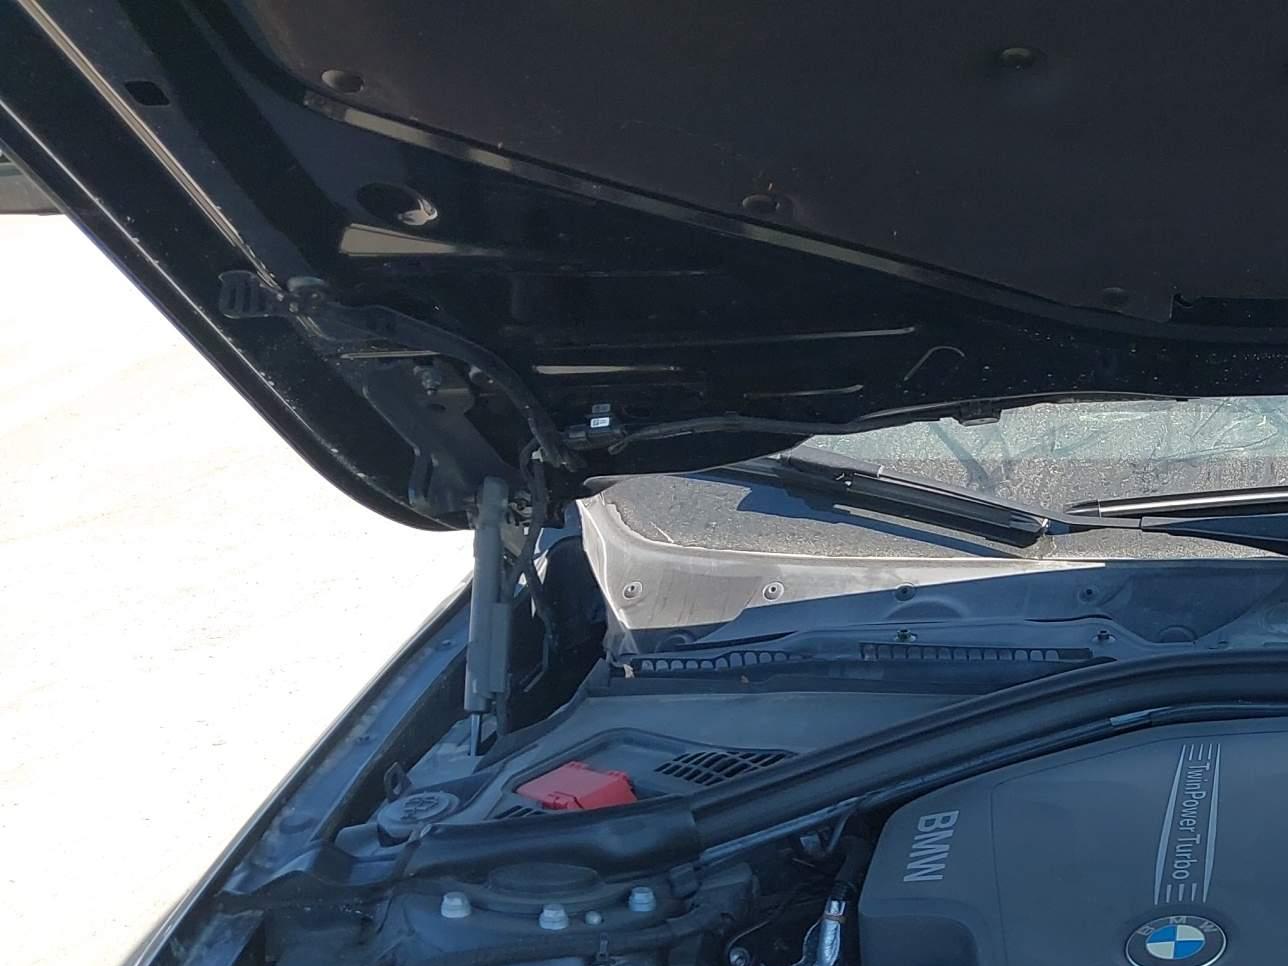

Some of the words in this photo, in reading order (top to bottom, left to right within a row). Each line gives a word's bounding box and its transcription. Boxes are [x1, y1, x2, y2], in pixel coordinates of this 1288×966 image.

[1181, 762, 1210, 832] TwinPower
[903, 809, 960, 882] BMW
[1171, 834, 1201, 880] Turbo
[1136, 915, 1218, 937] BMW
